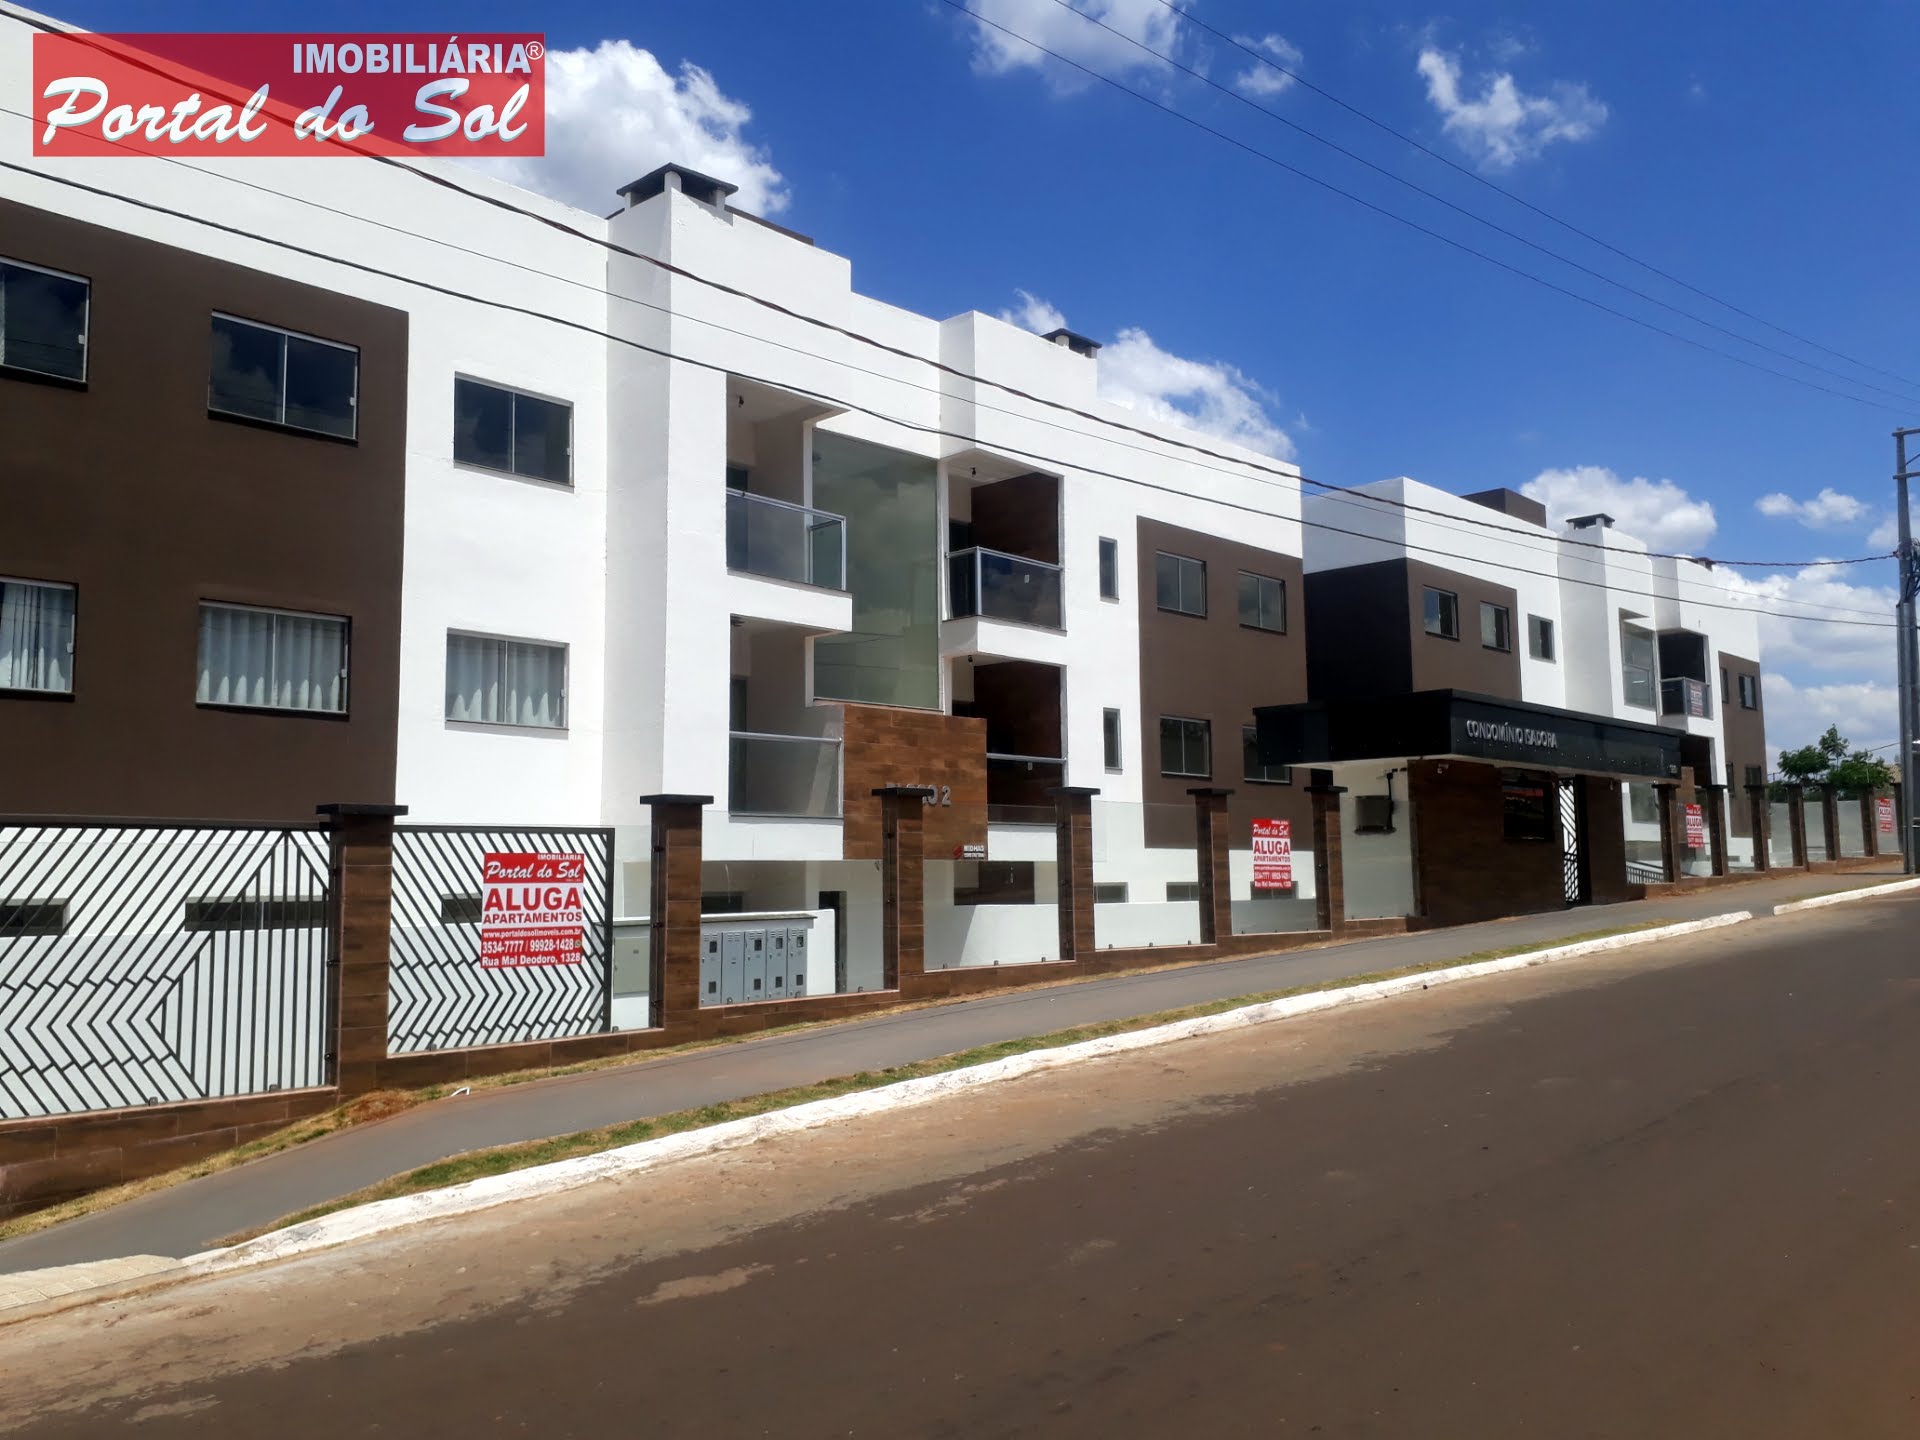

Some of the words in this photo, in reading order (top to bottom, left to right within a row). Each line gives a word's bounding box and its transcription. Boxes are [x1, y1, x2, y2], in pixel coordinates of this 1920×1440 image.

[1467, 720, 1523, 744] CONDOMÍNIO
[942, 786, 951, 806] 2
[1254, 841, 1290, 855] ALUGA
[486, 861, 534, 879] Portal
[537, 863, 553, 878] do
[556, 861, 581, 879] Sol
[484, 887, 582, 911] ALUGA
[483, 912, 582, 924] APARTAMENTOS
[482, 940, 524, 954] 3534-7777
[530, 938, 574, 952] 99928-1428
[482, 956, 499, 966] Rua
[502, 955, 517, 965] Mal
[520, 953, 558, 965] Deodoro,
[561, 952, 581, 963] 1328
